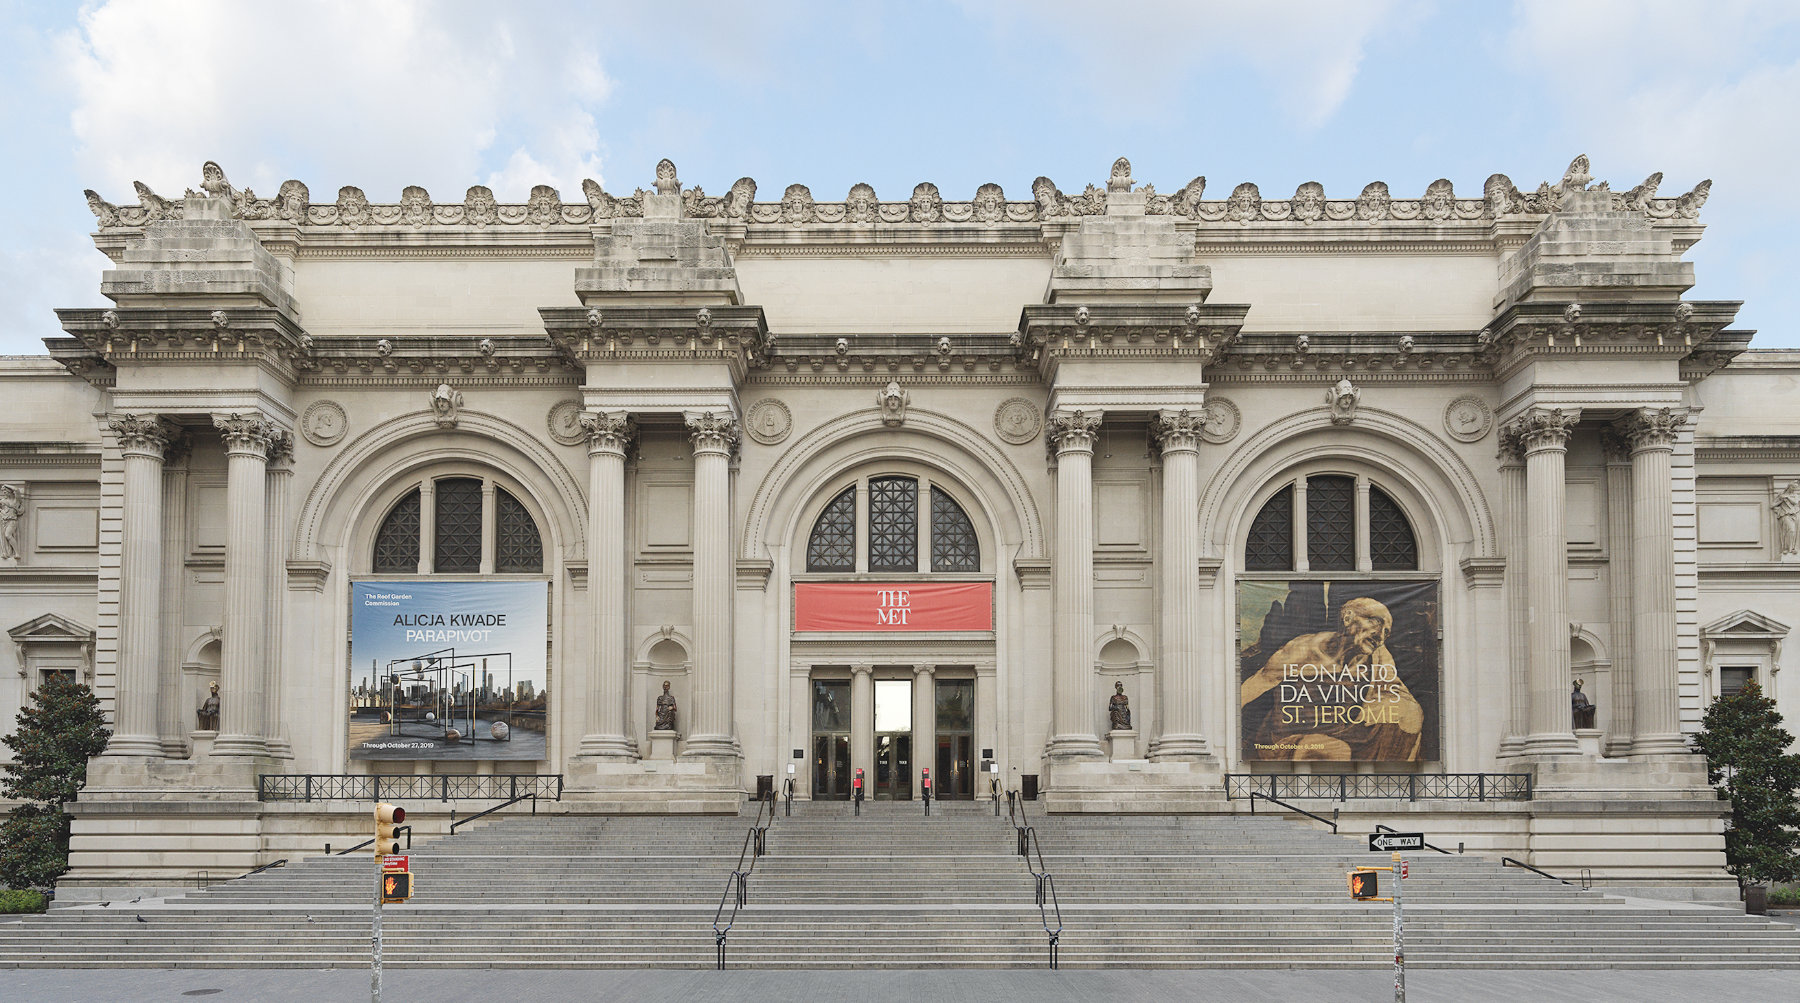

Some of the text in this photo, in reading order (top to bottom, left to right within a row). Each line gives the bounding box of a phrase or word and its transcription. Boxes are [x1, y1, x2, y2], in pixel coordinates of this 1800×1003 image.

[877, 590, 910, 607] THE
[393, 614, 506, 627] ALICJA KWADE
[876, 608, 911, 625] MET
[406, 630, 492, 643] PARAPIVOT
[1283, 663, 1398, 682] LEONARDO
[1280, 684, 1401, 704] DA VINCI'S
[1281, 705, 1400, 729] ST. JEROME
[1254, 743, 1279, 751] Through
[1377, 838, 1393, 847] ONE
